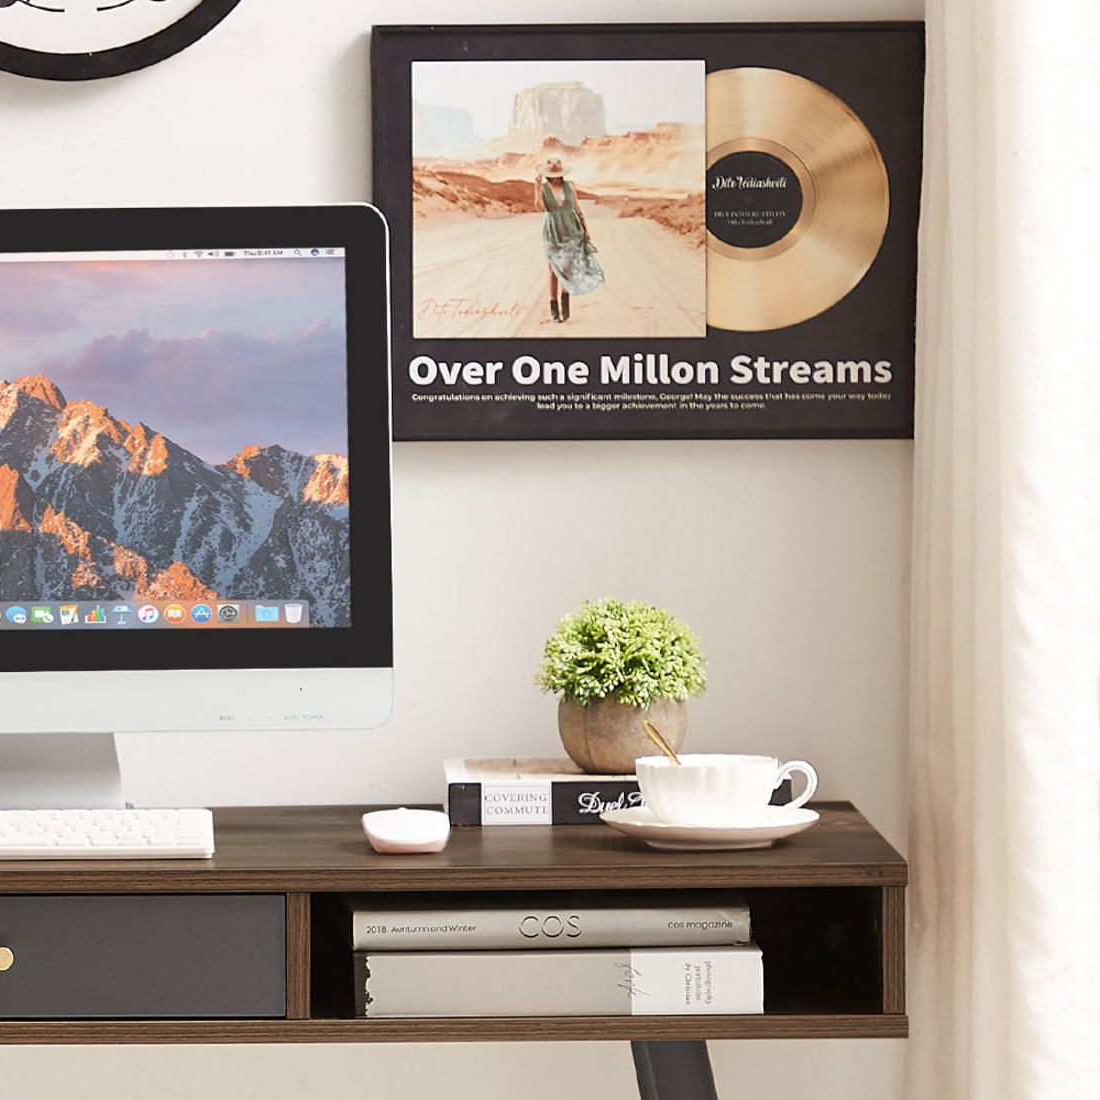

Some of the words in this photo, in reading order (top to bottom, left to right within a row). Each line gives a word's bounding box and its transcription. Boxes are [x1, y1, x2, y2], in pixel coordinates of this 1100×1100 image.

[408, 355, 504, 385] Over
[511, 355, 590, 385] One
[600, 353, 719, 385] Millon
[730, 354, 893, 384] Streams
[411, 393, 480, 402] Congratulations
[494, 392, 536, 402] achieving
[538, 392, 559, 401] such
[566, 392, 612, 402] significant
[614, 392, 659, 401] milestone,
[660, 393, 693, 402] George!
[694, 393, 712, 402] May
[714, 392, 729, 400] the
[765, 392, 783, 400] that
[784, 392, 800, 400] has
[827, 393, 846, 402] your
[848, 393, 865, 401] way
[867, 392, 891, 401] today
[537, 402, 555, 410] lead
[557, 403, 573, 412] you
[574, 402, 584, 410] to
[592, 402, 620, 411] bigger
[621, 402, 677, 410] achievement
[705, 402, 729, 411] years
[484, 793, 548, 802] COVERING
[486, 805, 549, 815] COMMUTE
[366, 925, 387, 934] 2018
[448, 924, 477, 932] Winter
[519, 915, 582, 938] COS
[667, 921, 684, 929] cos
[686, 920, 733, 930] magazine
[683, 963, 692, 972] by
